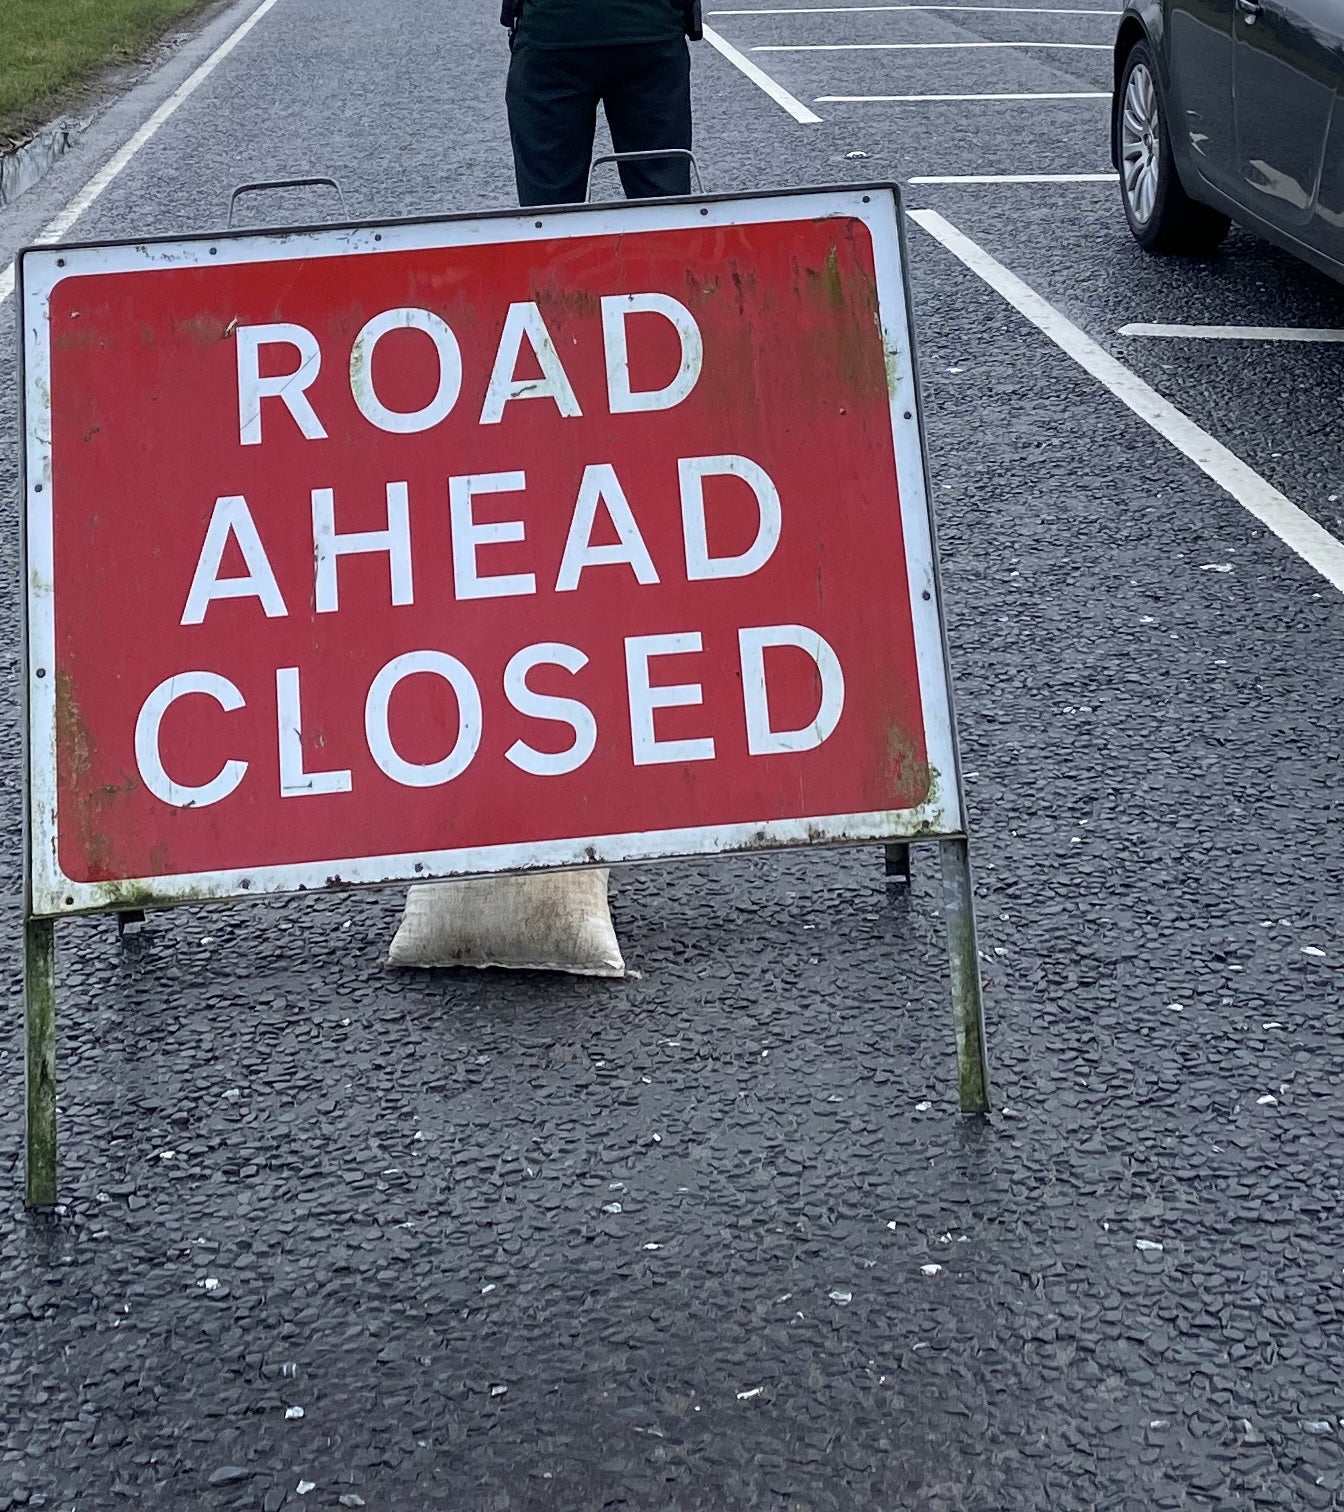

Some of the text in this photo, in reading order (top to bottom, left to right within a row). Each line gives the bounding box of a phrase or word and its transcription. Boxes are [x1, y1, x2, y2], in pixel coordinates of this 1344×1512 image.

[235, 292, 704, 446] ROAD
[179, 454, 783, 626] AHEAD
[133, 624, 846, 808] CLOSED
